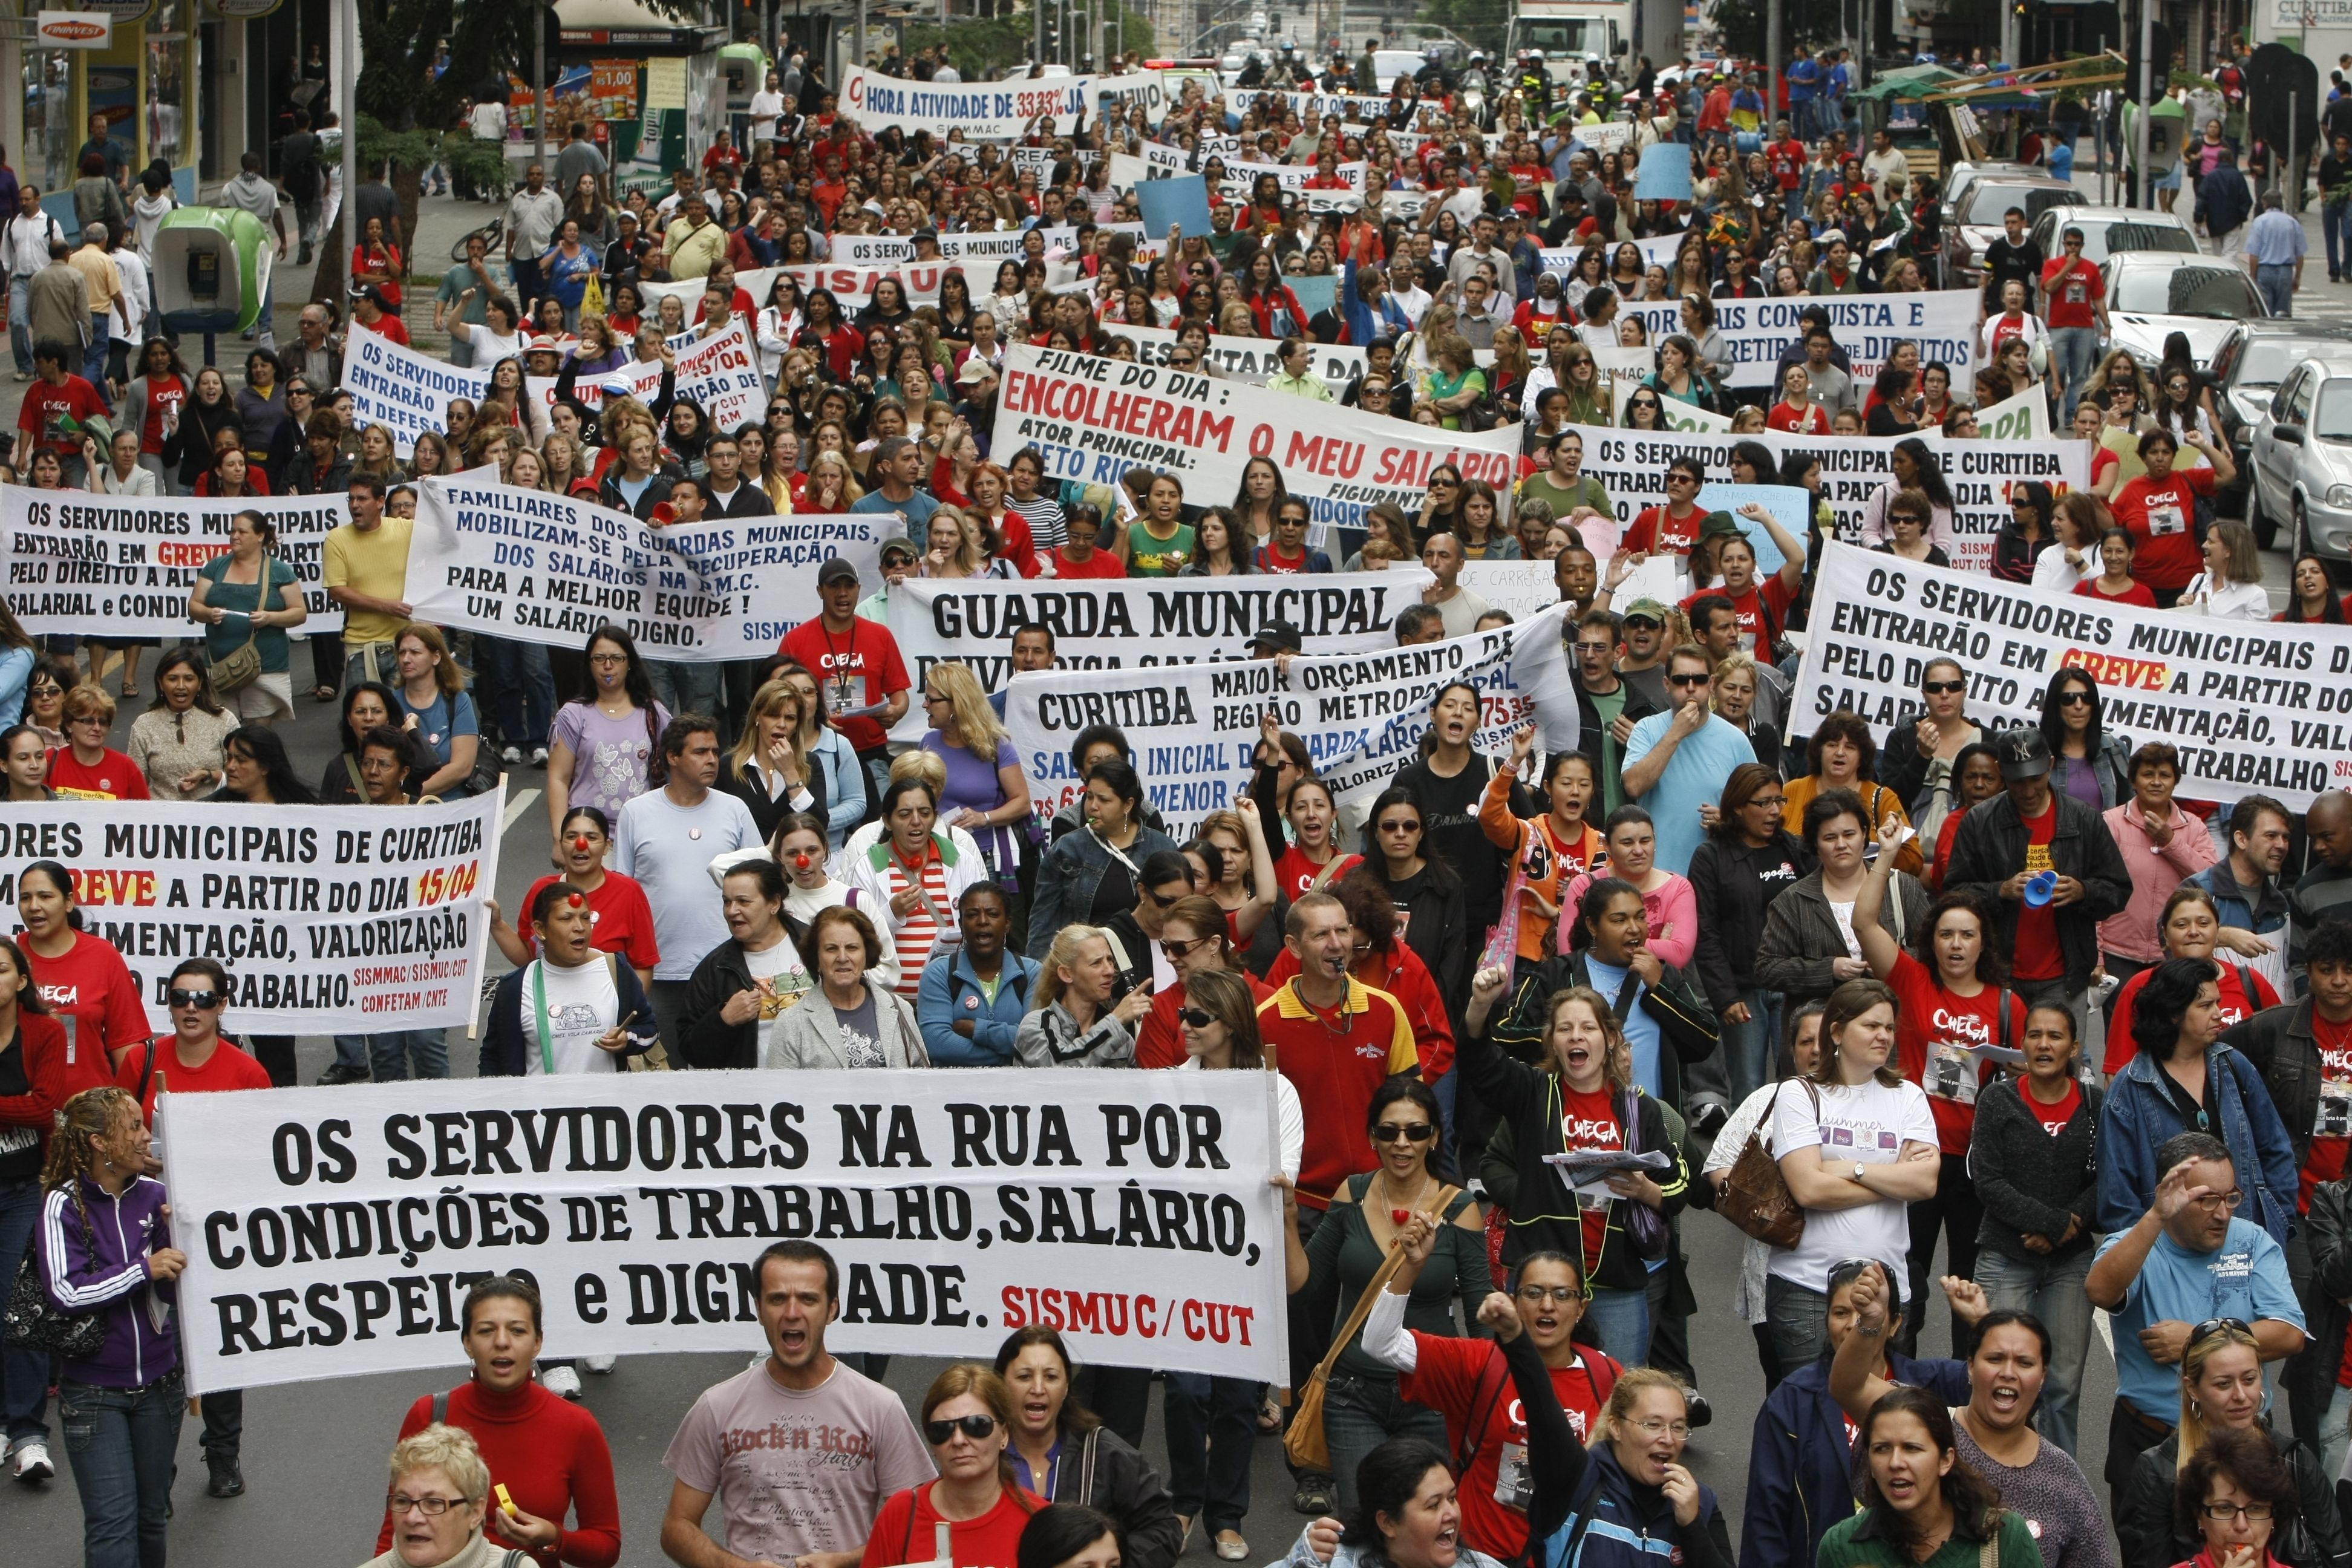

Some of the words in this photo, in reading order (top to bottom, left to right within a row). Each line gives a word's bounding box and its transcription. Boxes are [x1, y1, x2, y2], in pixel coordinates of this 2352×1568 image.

[45, 25, 101, 35] FININVEST
[606, 71, 632, 88] 1,00
[867, 86, 905, 116] HORA
[910, 92, 988, 119] ATIVIDADE
[995, 93, 1014, 118] DE
[1065, 80, 1087, 114] JÁ
[937, 125, 1001, 134] SIMMAC
[854, 244, 870, 259] OS
[875, 241, 960, 258] SERVIES
[1055, 236, 1071, 250] DE
[1714, 307, 1746, 329] AIS
[1758, 302, 1894, 328] CONUISTA
[1907, 303, 1924, 326] E
[363, 342, 382, 365] OS
[351, 364, 434, 412] ENTRARÃO
[737, 373, 759, 389] DE
[1036, 350, 1112, 382] FILME
[1120, 365, 1157, 390] DO
[1166, 373, 1209, 402] DIA
[157, 390, 183, 403] CHEGA
[376, 402, 445, 436] DEFESA
[1004, 370, 1235, 454] ENCOLHERAM
[1249, 423, 1275, 458] O
[1284, 431, 1365, 479] MEU
[1018, 419, 1074, 446] ATOR
[1078, 431, 1196, 469] PRINCIPAL:
[1600, 440, 1625, 462] OS
[1962, 451, 2062, 475] CURITIBA
[2145, 491, 2179, 506] CHEGA
[28, 501, 51, 527] OS
[59, 505, 190, 535] SERVIDORES
[203, 508, 338, 535] MUCIPAIS
[447, 489, 577, 524] FAMILIARES
[592, 514, 627, 541] DOS
[639, 529, 734, 556] GUARDAS
[747, 524, 880, 545] MUNICIPAIS,
[13, 532, 108, 563] ENTRARÃO
[119, 544, 146, 564] EM
[456, 511, 612, 557] MOBILIZAM-SE
[622, 546, 674, 568] PELA
[687, 541, 837, 577] RECUPERAÇÃO
[10, 563, 47, 584] PELO
[56, 561, 137, 585] DIREITO
[146, 568, 158, 586] A
[494, 542, 535, 569] DOS
[548, 551, 647, 586] SALÁRIOS
[659, 571, 687, 590] NA
[1463, 571, 1478, 586] DE
[8, 593, 96, 615] SALARIAL
[103, 597, 113, 616] e
[446, 566, 507, 594] PARA
[518, 575, 534, 598] A
[546, 578, 641, 613] MELHOR
[467, 595, 502, 621] UM
[514, 603, 610, 634] SALÁRIO
[627, 619, 703, 647] DIGNO.
[932, 591, 1140, 639] GUARDA
[1148, 587, 1394, 638] MUNICIPAL
[1866, 568, 1906, 602] OS
[1921, 579, 2114, 645] SERVIDORES
[2128, 623, 2314, 670] MUNICIPAIS
[1822, 642, 1894, 683] PELO
[1831, 601, 1990, 660] ENTRARÃO
[2000, 641, 2047, 672] EM
[2060, 648, 2166, 691] GREVE
[2169, 671, 2189, 694] A
[2198, 671, 2311, 709] PARTIR
[1039, 686, 1198, 731] CURITIBA
[1212, 665, 1290, 698] MAIOR
[1303, 644, 1463, 692] ORÇAMENTO
[1213, 696, 1301, 731] REGIÃO
[1148, 742, 1230, 776] INICIAL
[2179, 746, 2334, 793] TRABALHO.
[1150, 781, 1227, 812] MENOR
[105, 823, 317, 864] MUNICIPAIS
[335, 830, 370, 864] DE
[381, 816, 482, 863] CURITIBA
[166, 878, 189, 907] A
[202, 873, 319, 912] PARTIR
[328, 881, 361, 913] DO
[368, 877, 409, 911] DIA
[417, 859, 479, 907] 15/04
[307, 906, 467, 962] VALORIZAÇÃO
[1933, 1008, 1989, 1044] CHEGA
[1563, 1114, 1621, 1143] CHEGA
[1823, 1115, 1886, 1131] summer
[273, 1119, 357, 1186] OS
[384, 1102, 808, 1180] SERVIDORES
[833, 1102, 932, 1169] NA
[945, 1103, 1082, 1168] RUA
[1099, 1103, 1230, 1170] POR
[205, 1185, 550, 1270] CONDIÇÕES
[561, 1195, 632, 1243] DE
[639, 1185, 991, 1249] TRABALHO,
[575, 1272, 607, 1325] e
[619, 1261, 988, 1328] DIGNADE.
[1002, 1284, 1255, 1347] SISMUC/CUT
[808, 1449, 864, 1471] Party
